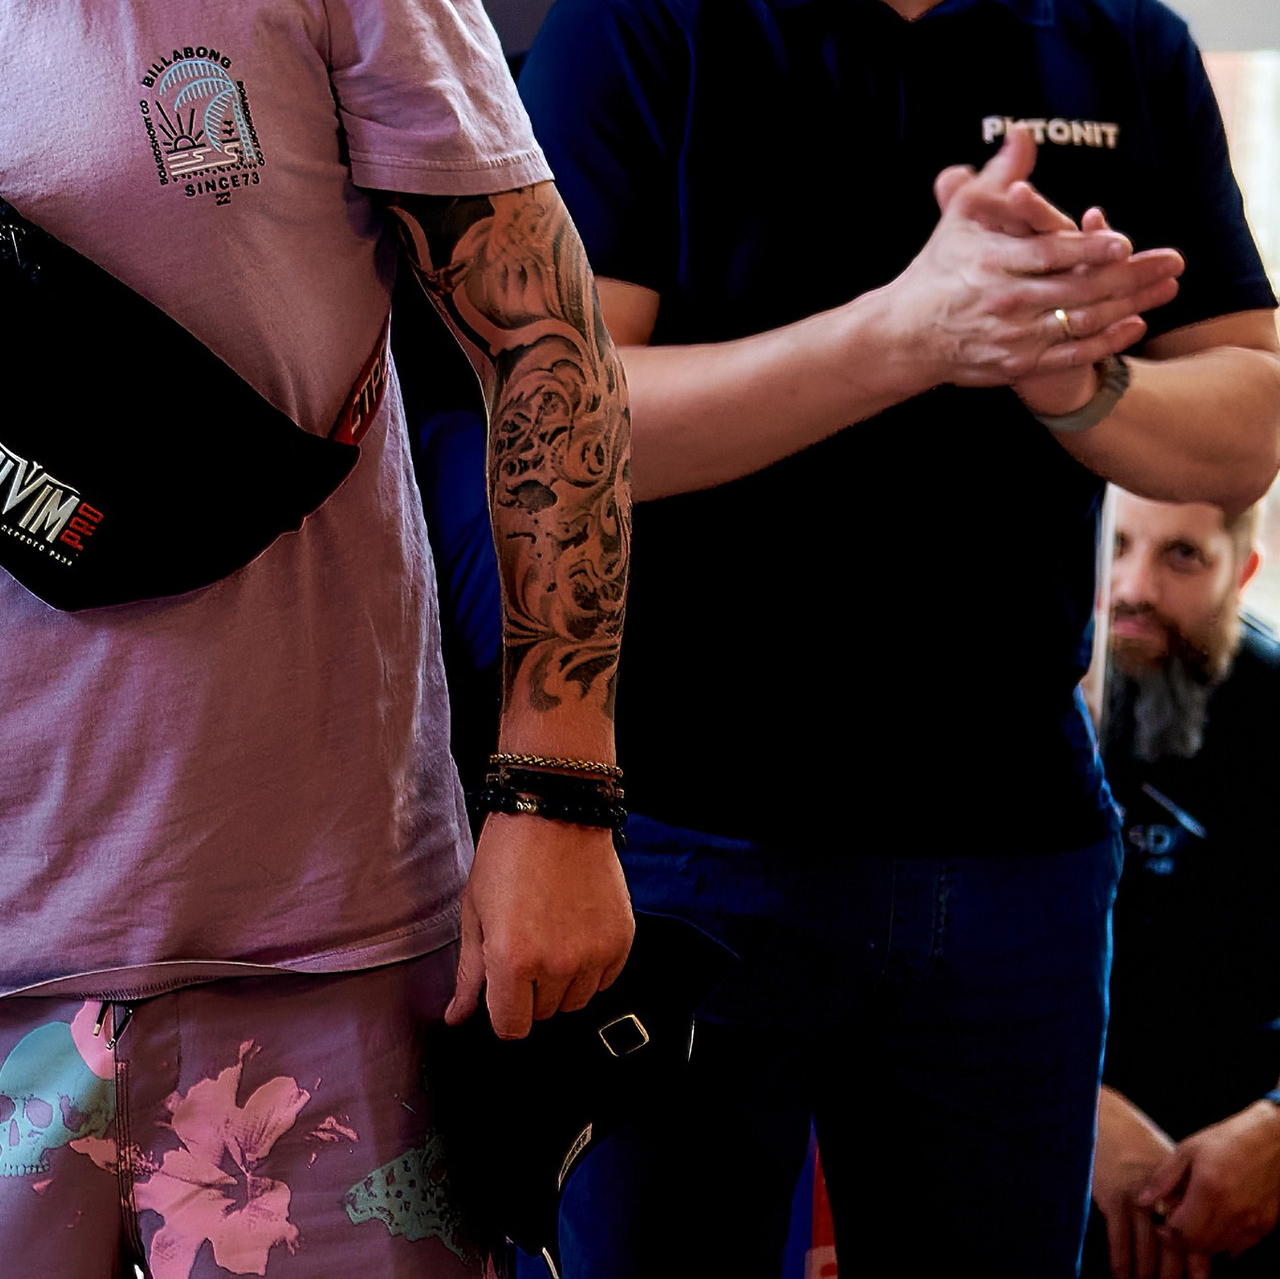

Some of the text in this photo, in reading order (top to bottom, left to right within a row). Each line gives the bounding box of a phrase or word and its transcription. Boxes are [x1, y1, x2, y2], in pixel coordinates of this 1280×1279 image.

[142, 46, 232, 88] BILLABONG
[140, 100, 169, 186] BOARDSHORT CO
